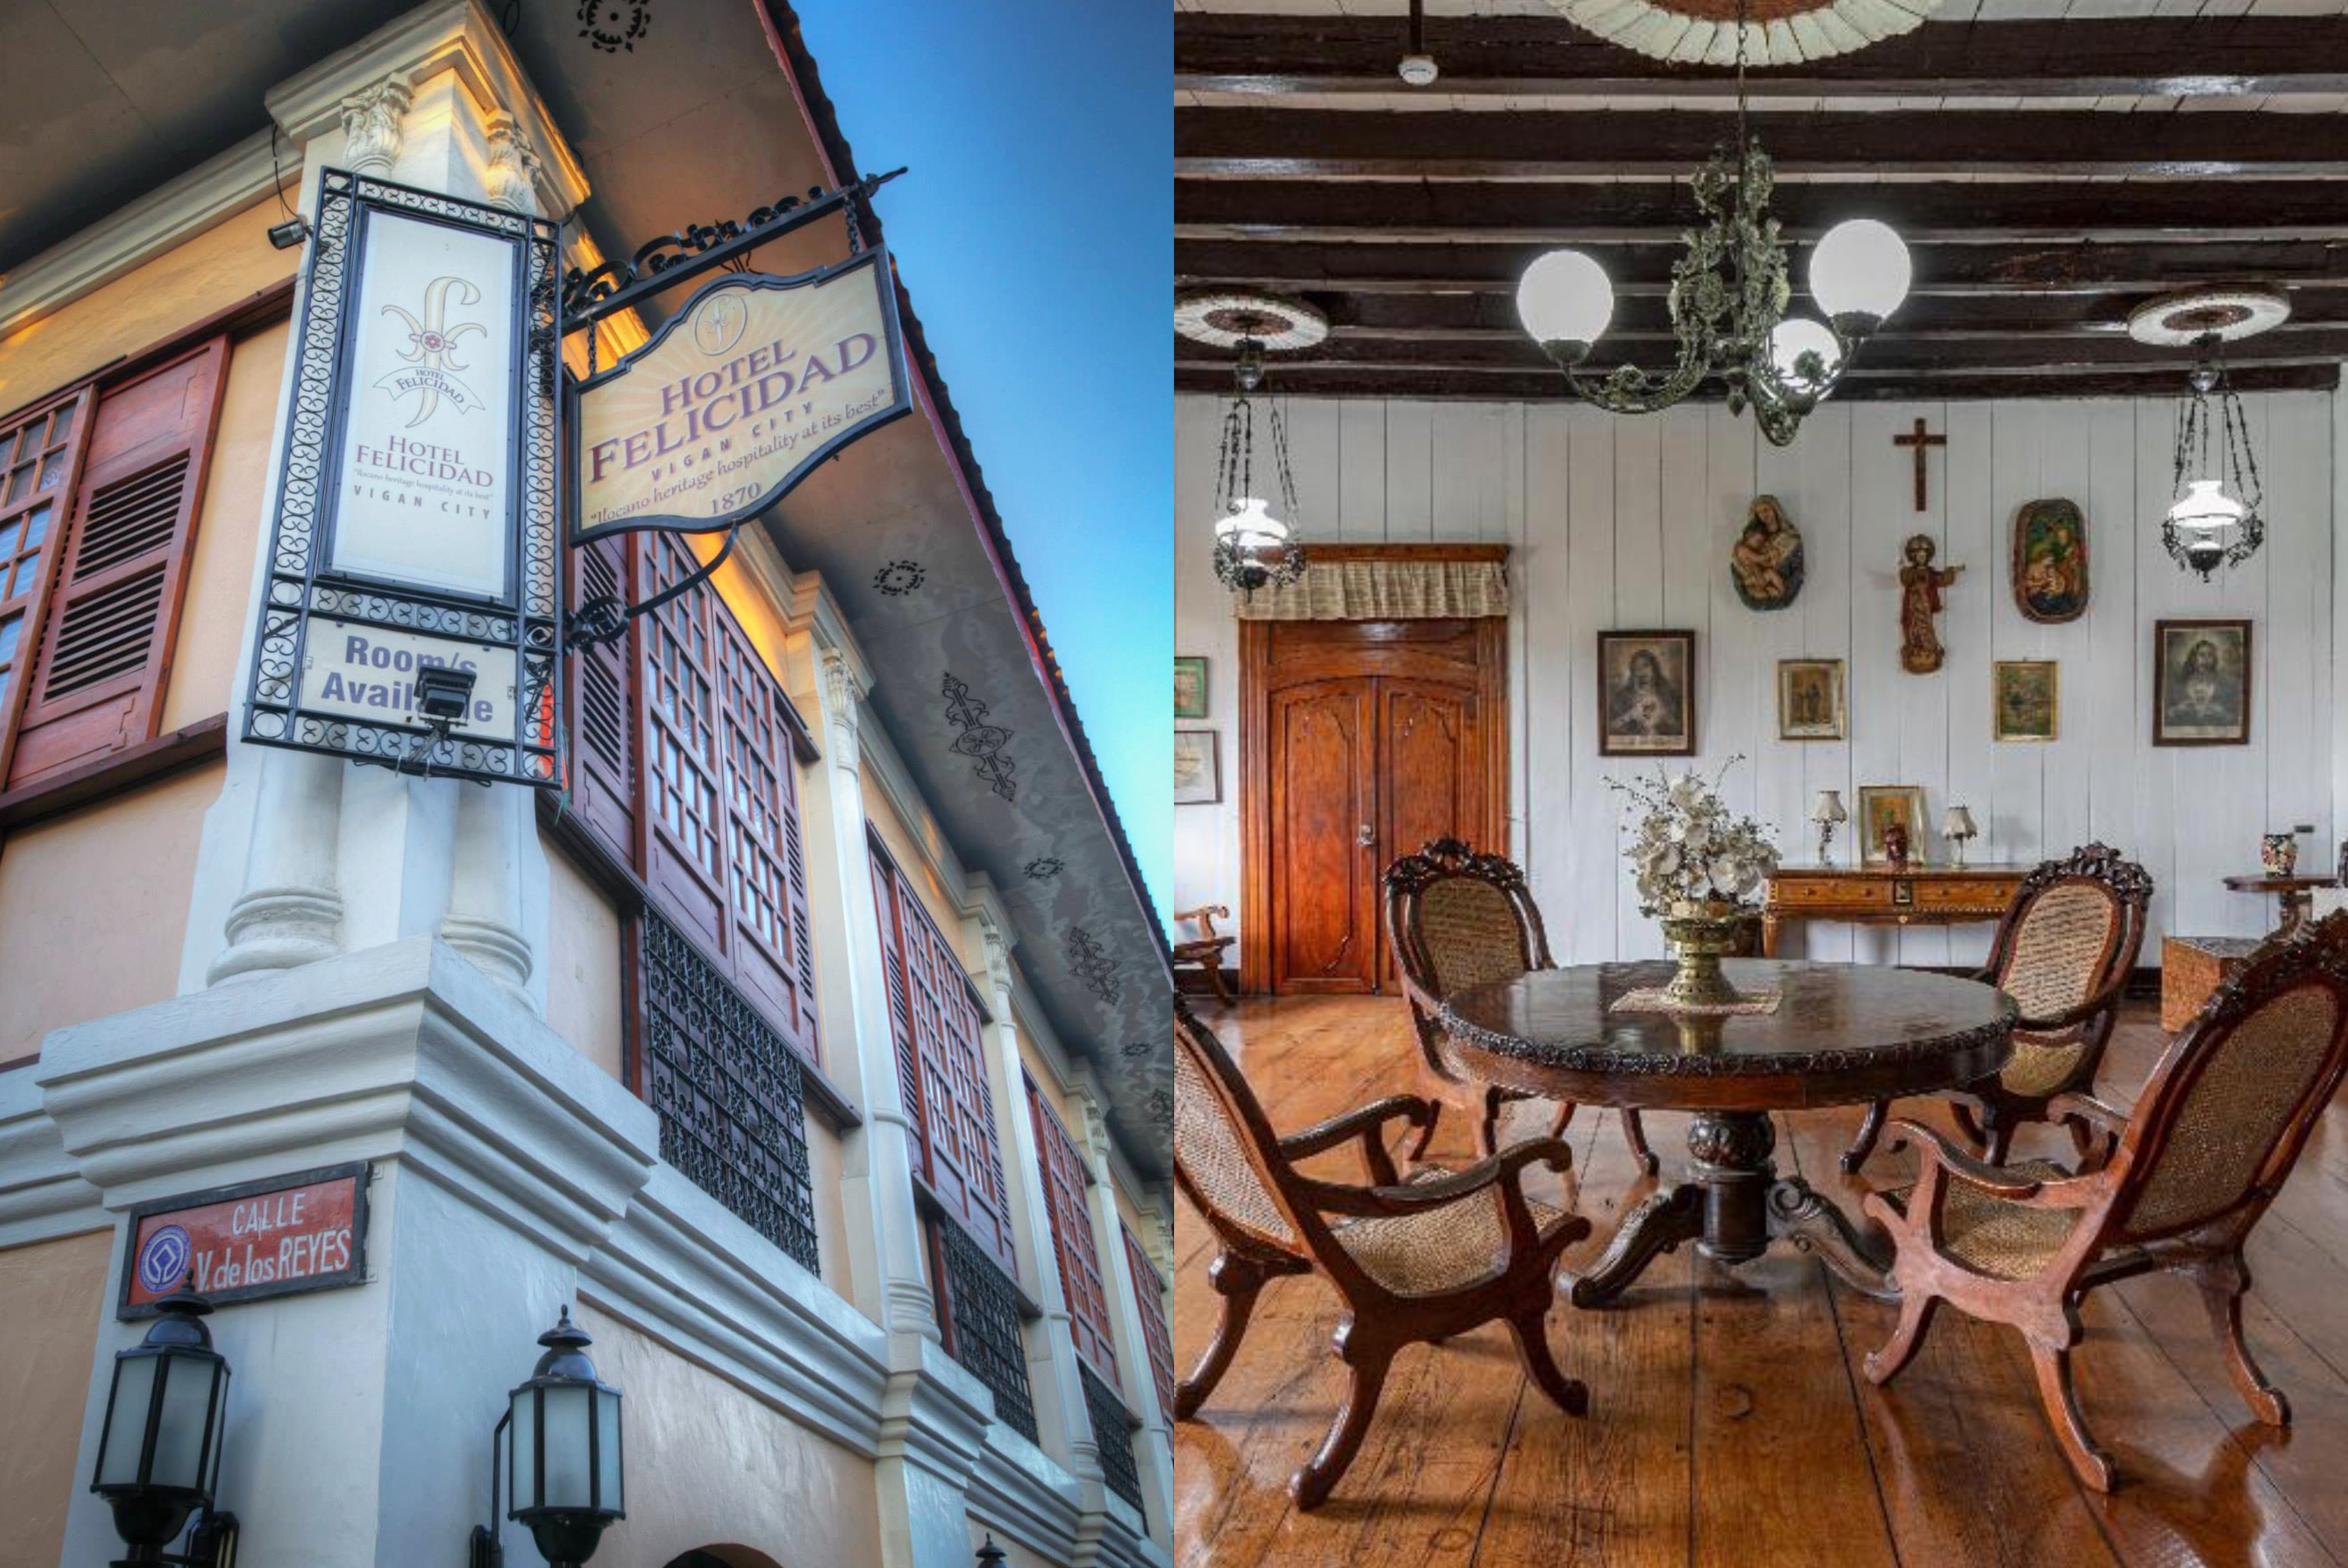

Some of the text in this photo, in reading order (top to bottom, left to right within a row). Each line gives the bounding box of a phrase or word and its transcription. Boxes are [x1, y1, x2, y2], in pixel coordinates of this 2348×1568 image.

[395, 376, 464, 404] FELICIDAD
[415, 369, 445, 381] HOTEL
[661, 339, 796, 416] HOTEL
[589, 333, 877, 483] FELICIDAD
[389, 435, 464, 465] HOTEL
[652, 401, 813, 481] VIGAN CITY
[654, 470, 713, 503] heritage
[718, 432, 799, 476] hospitality
[802, 422, 818, 438] at
[822, 415, 841, 431] its
[356, 444, 493, 487] FELICIDAD
[354, 484, 490, 519] VIGAN CITY
[712, 482, 762, 514] 1870
[321, 672, 493, 721] Availe
[232, 1193, 307, 1236] CALLE
[213, 1246, 241, 1288] de
[243, 1244, 275, 1285] los
[276, 1230, 351, 1280] REYES
